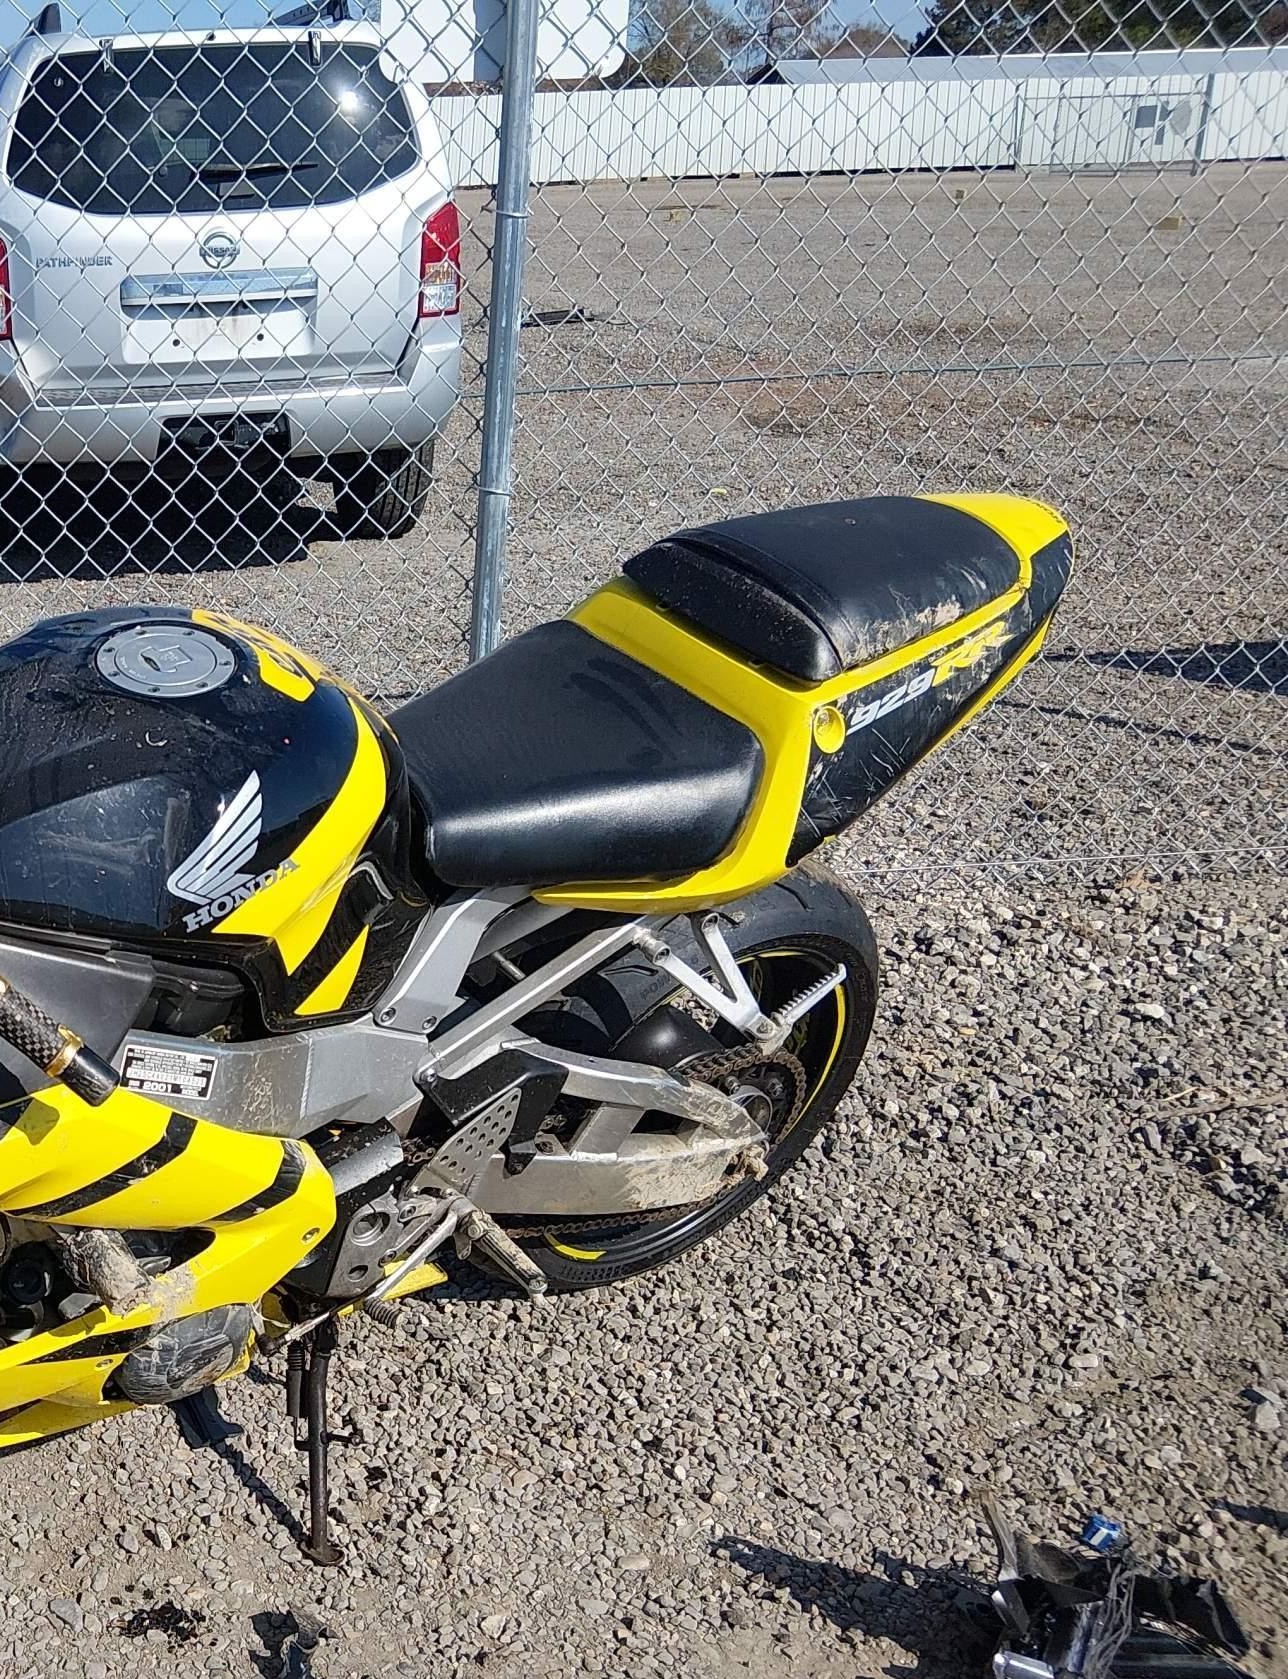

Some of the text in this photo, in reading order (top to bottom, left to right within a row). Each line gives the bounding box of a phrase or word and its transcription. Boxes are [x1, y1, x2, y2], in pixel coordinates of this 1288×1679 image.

[846, 668, 936, 736] 929
[182, 857, 300, 933] HONDA
[143, 1081, 172, 1093] 2001
